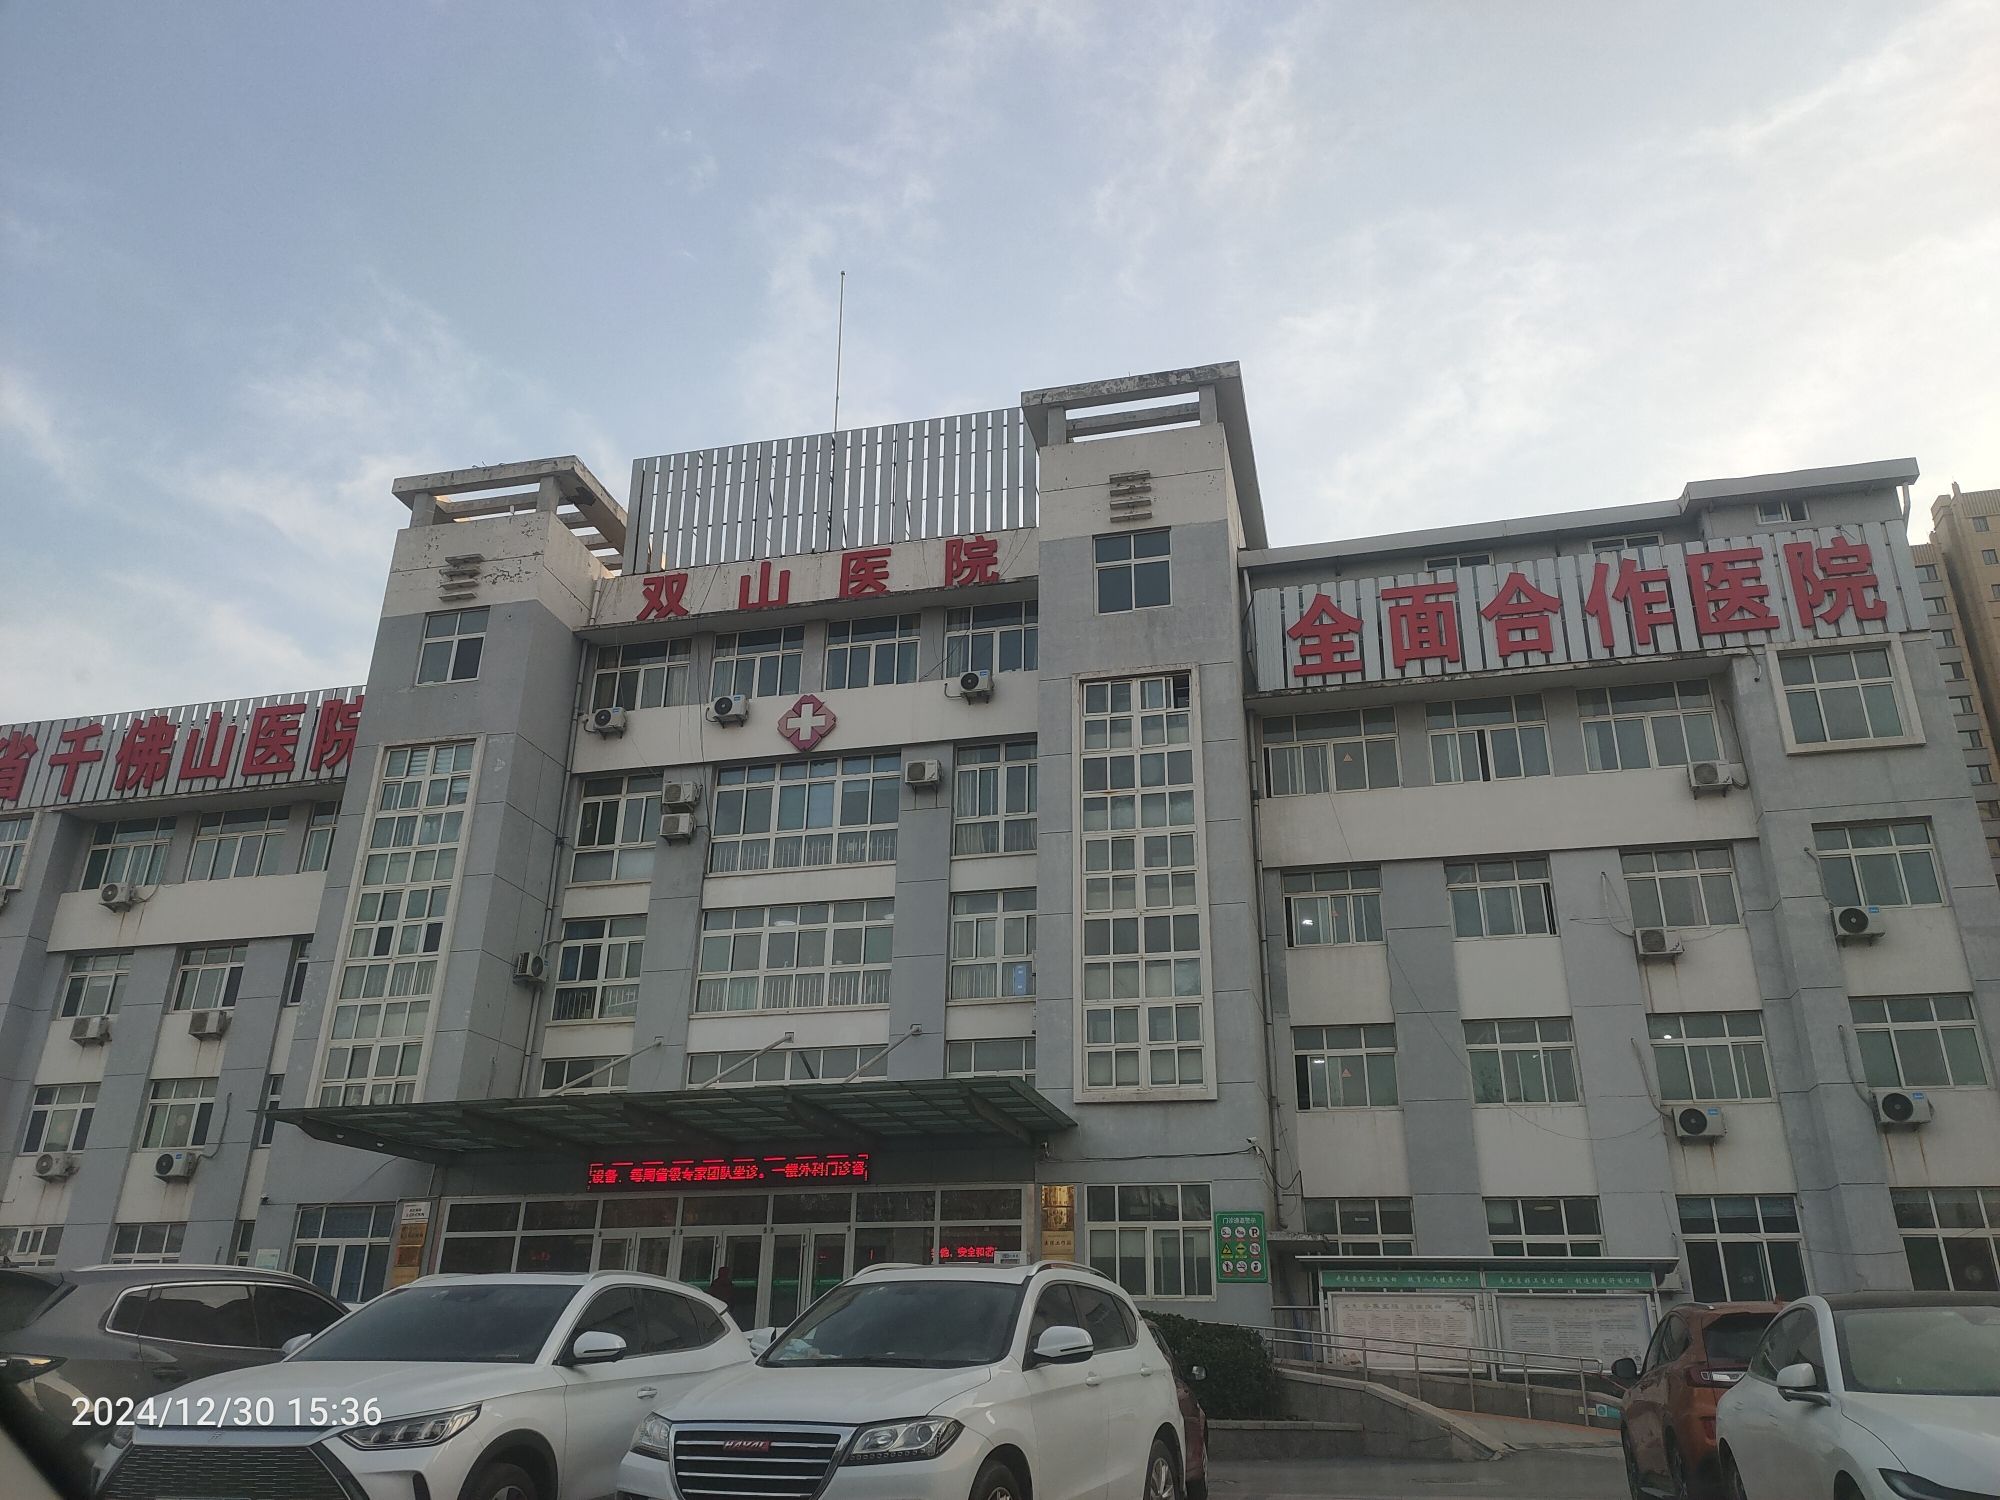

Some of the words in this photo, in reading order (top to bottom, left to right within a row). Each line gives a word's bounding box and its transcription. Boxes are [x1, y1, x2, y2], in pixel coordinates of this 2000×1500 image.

[636, 535, 1001, 621] 双山医院
[1286, 536, 1888, 677] 全面合作医院
[0, 695, 364, 801] 省千佛山医院
